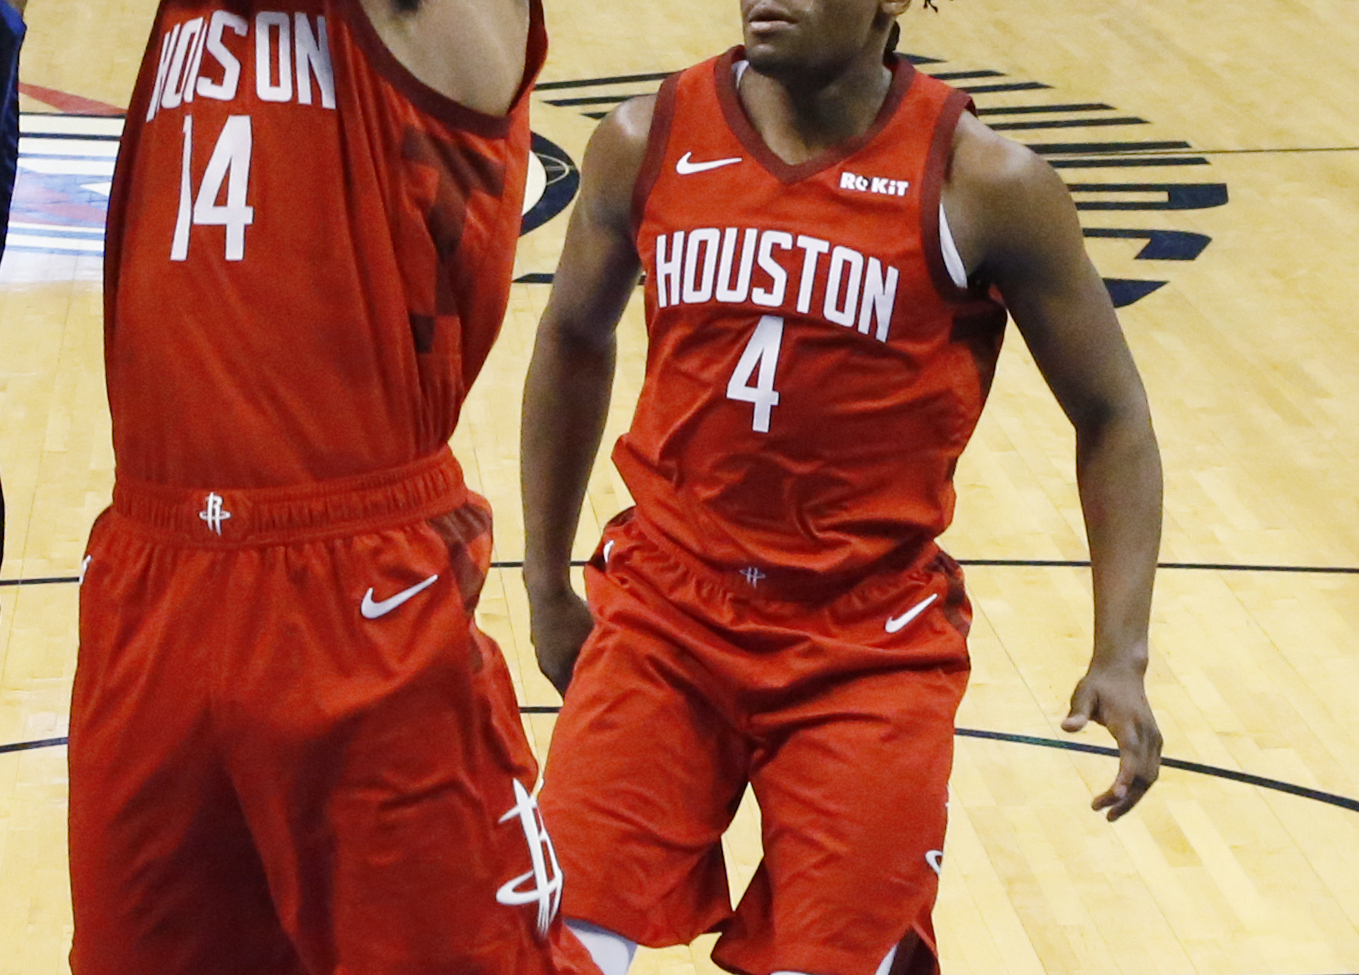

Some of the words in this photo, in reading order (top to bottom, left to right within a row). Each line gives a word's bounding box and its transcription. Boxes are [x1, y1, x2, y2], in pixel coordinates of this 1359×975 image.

[170, 114, 254, 262] 14
[656, 227, 900, 344] HOUSTON
[726, 314, 780, 434] 4
